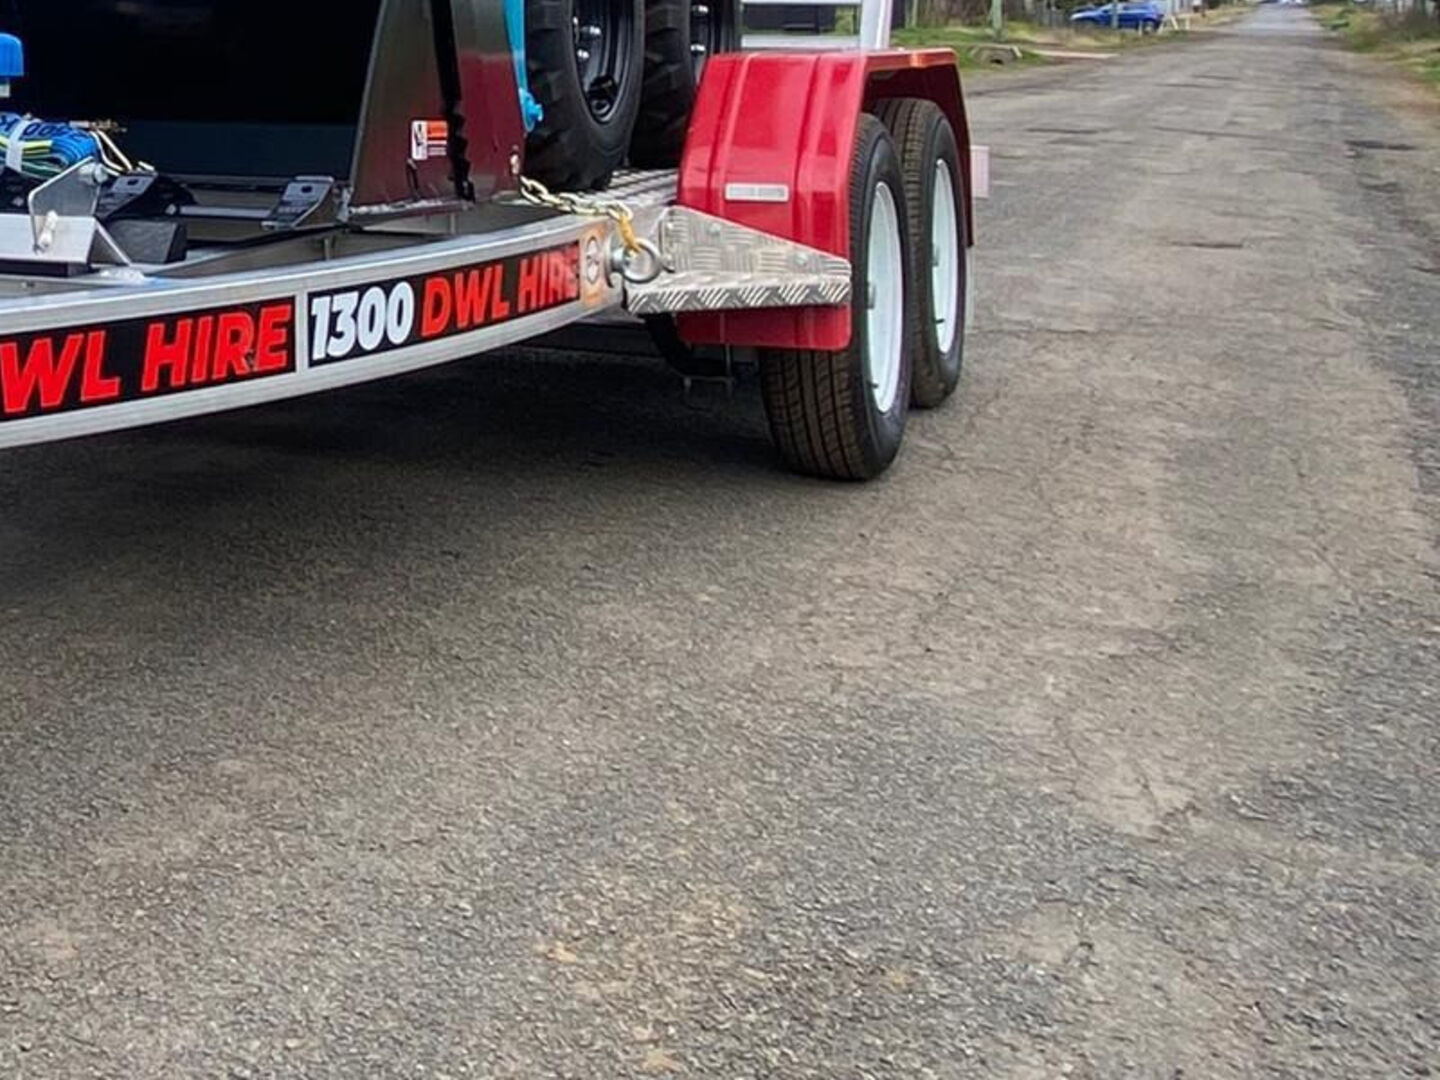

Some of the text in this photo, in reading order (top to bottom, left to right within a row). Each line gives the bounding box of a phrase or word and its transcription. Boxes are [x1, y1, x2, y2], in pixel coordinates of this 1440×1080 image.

[140, 303, 293, 392] HIRE
[312, 281, 415, 360] 1300
[421, 264, 509, 338] DWL
[517, 243, 580, 313] HIRE
